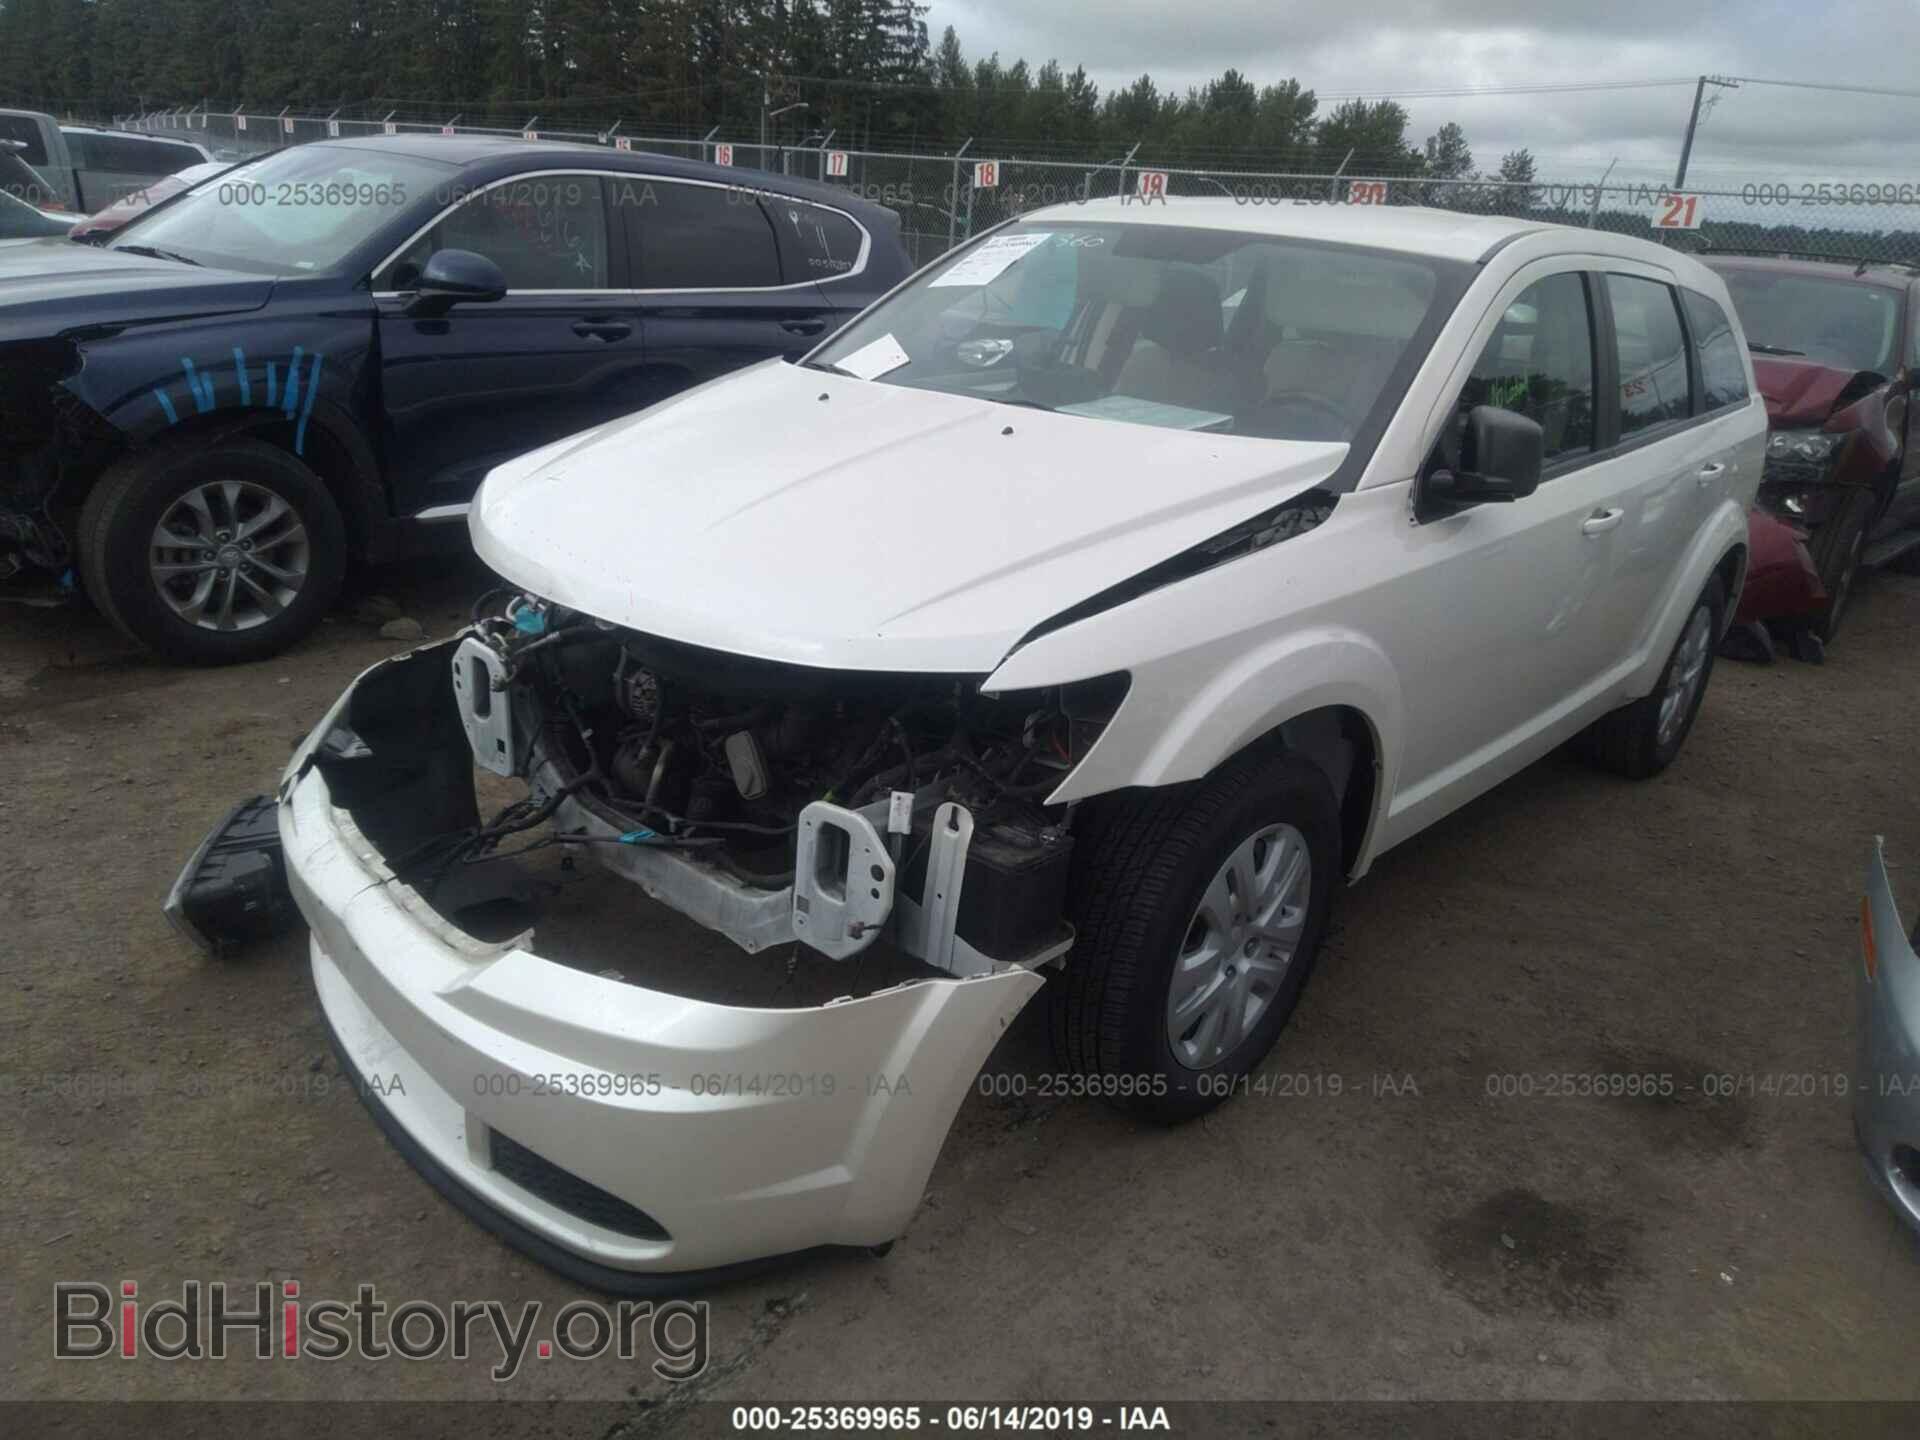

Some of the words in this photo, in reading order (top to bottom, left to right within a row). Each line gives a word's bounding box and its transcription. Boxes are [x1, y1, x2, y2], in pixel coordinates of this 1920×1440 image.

[717, 145, 730, 166] 16
[830, 153, 846, 174] 17
[978, 163, 995, 185] 18
[1143, 173, 1163, 195] 19
[1659, 196, 1698, 227] 21
